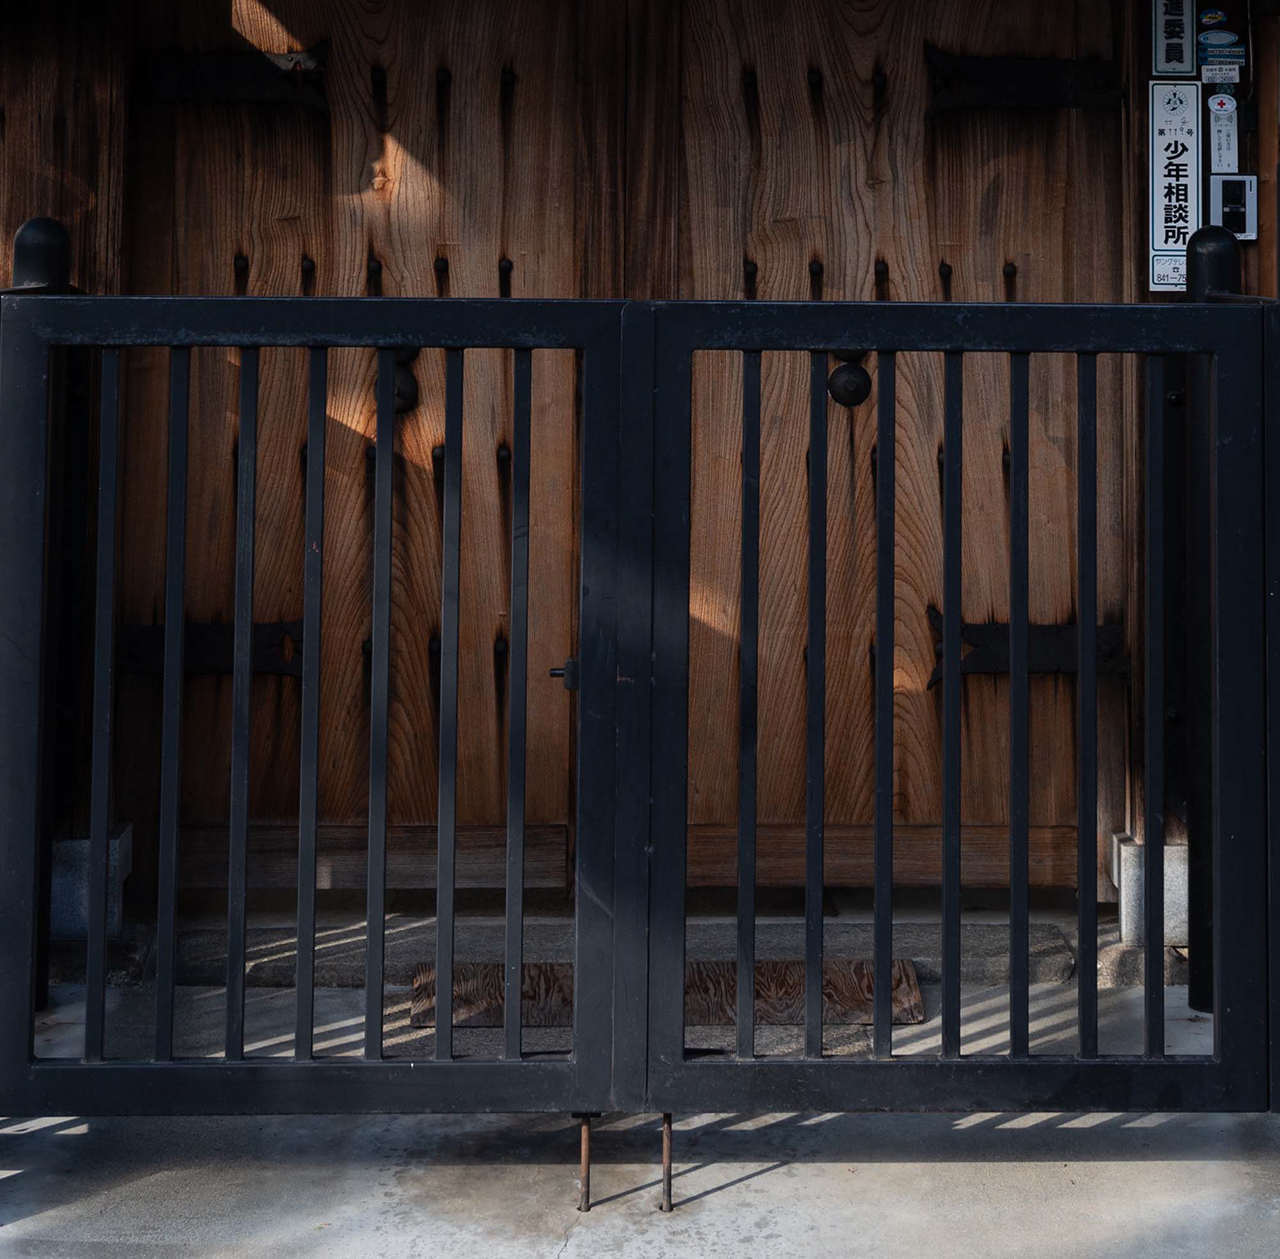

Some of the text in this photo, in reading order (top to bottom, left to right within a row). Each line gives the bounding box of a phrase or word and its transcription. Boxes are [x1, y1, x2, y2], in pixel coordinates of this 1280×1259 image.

[1163, 140, 1189, 246] 少年相談所
[1156, 257, 1187, 266] ヤングテレ
